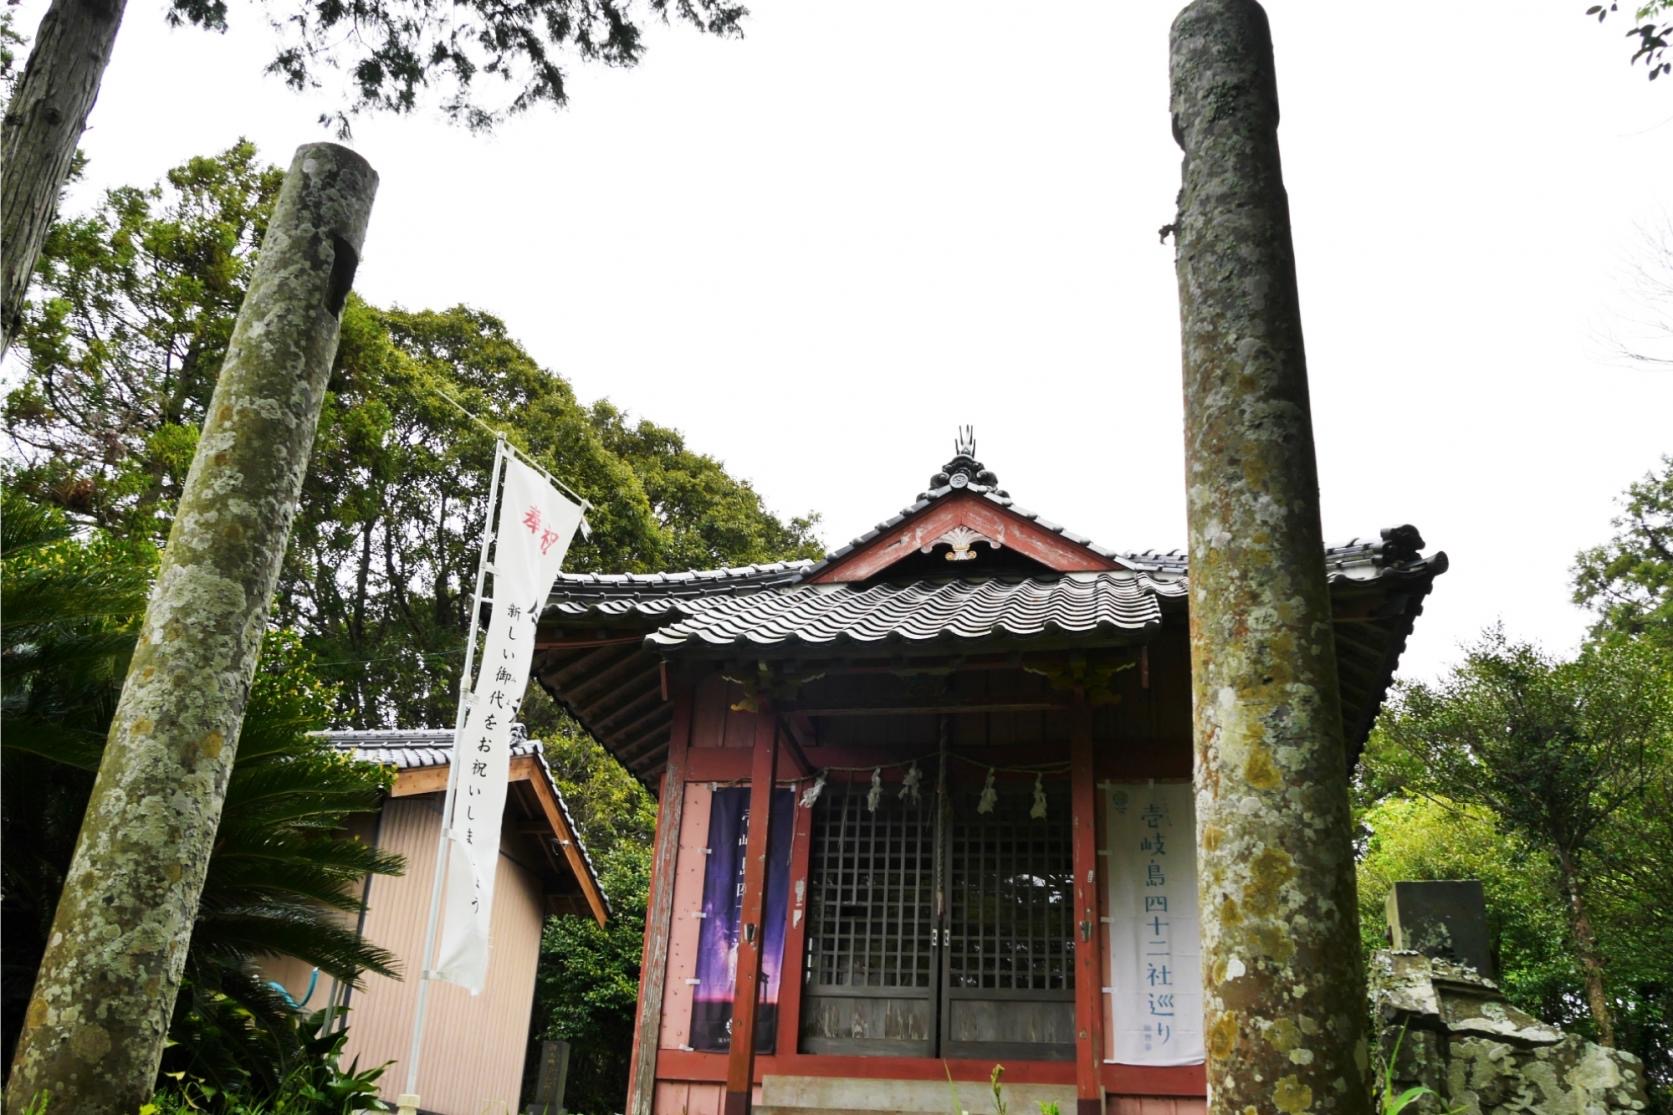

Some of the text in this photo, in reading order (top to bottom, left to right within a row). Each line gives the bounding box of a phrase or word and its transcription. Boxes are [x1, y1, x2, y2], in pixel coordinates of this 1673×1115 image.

[522, 503, 560, 556] 奉祝
[1140, 803, 1175, 1046] 壱岐島四十二社巡り
